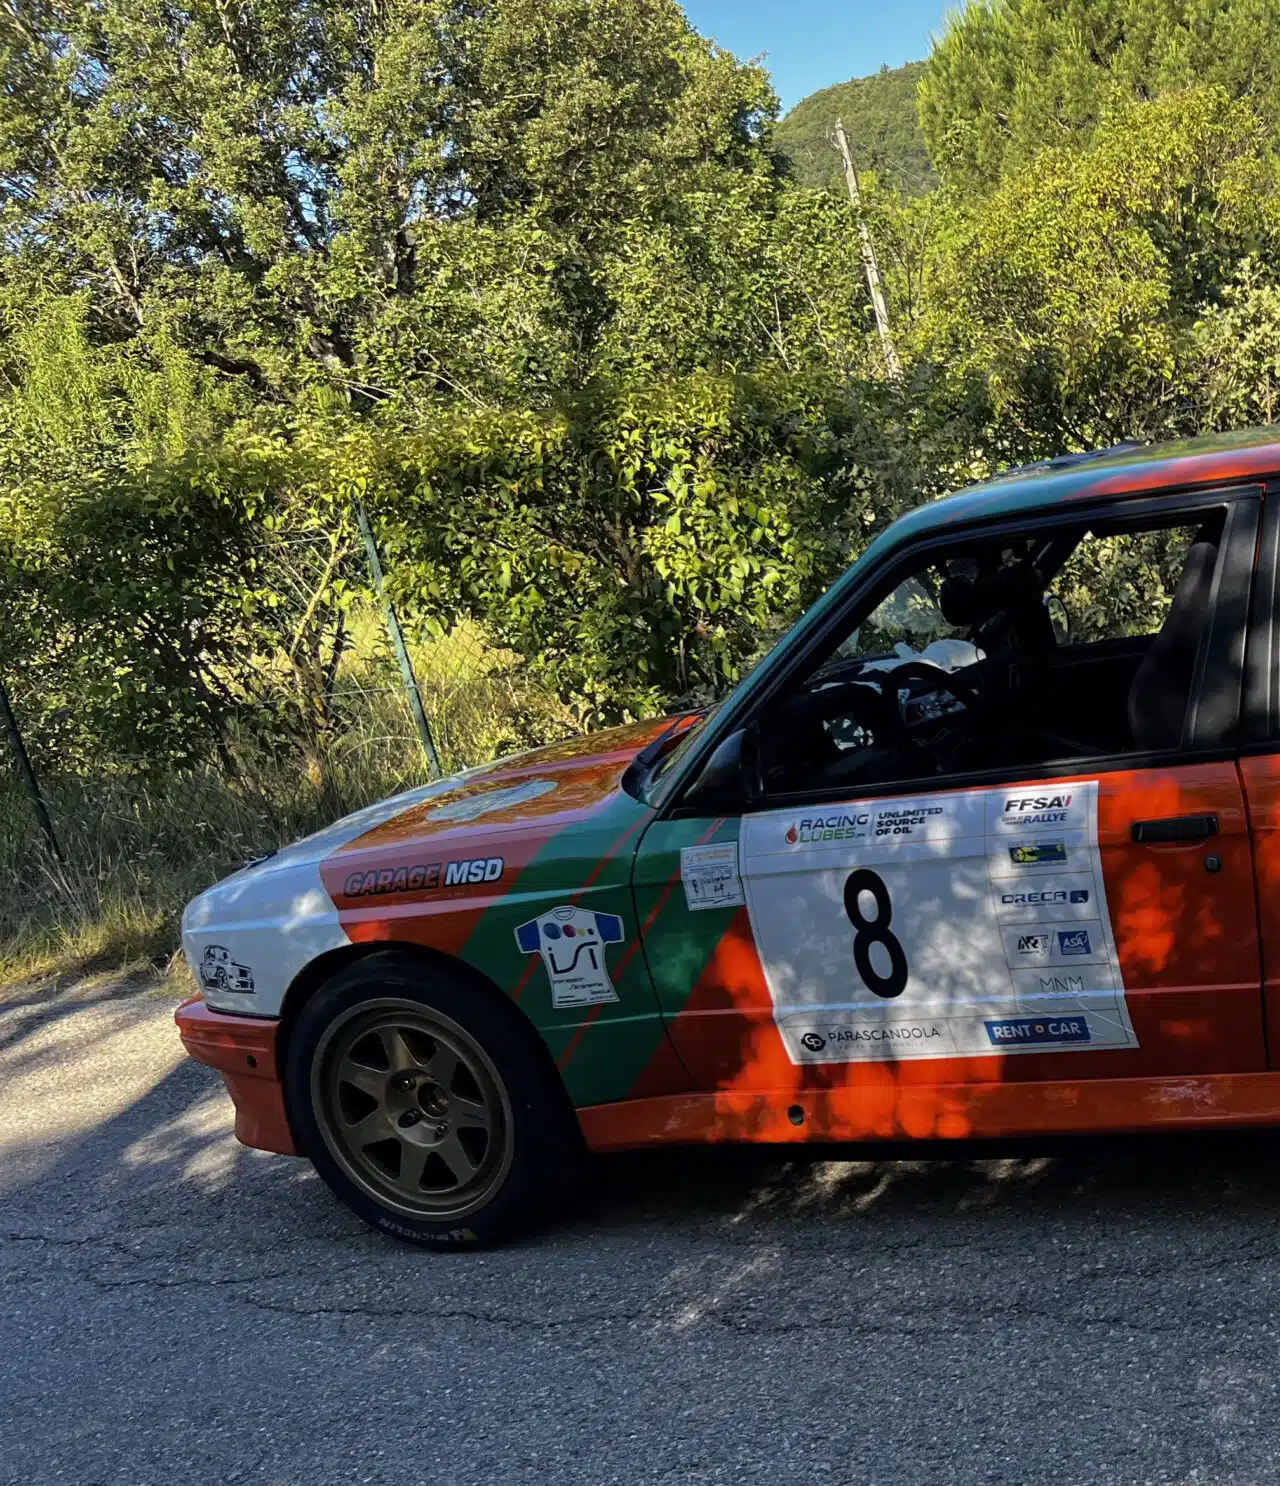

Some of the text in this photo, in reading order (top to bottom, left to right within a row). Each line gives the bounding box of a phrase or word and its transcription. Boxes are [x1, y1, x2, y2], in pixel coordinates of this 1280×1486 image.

[1004, 795, 1064, 812] FFSA
[878, 807, 943, 820] UNLIMITED
[1023, 812, 1068, 824] RALLYE
[800, 814, 869, 831] RACING
[876, 817, 926, 828] SOURCE
[800, 827, 857, 843] LUBES
[875, 828, 891, 836] OF
[893, 826, 912, 835] OIL
[344, 857, 504, 897] GARAGE MSD
[1001, 891, 1067, 904] ORECA
[843, 868, 909, 999] 8
[1040, 976, 1085, 992] MNM
[828, 1027, 941, 1042] PARASCANDOLA
[992, 1024, 1031, 1038] RENT
[1048, 1022, 1082, 1034] CAR
